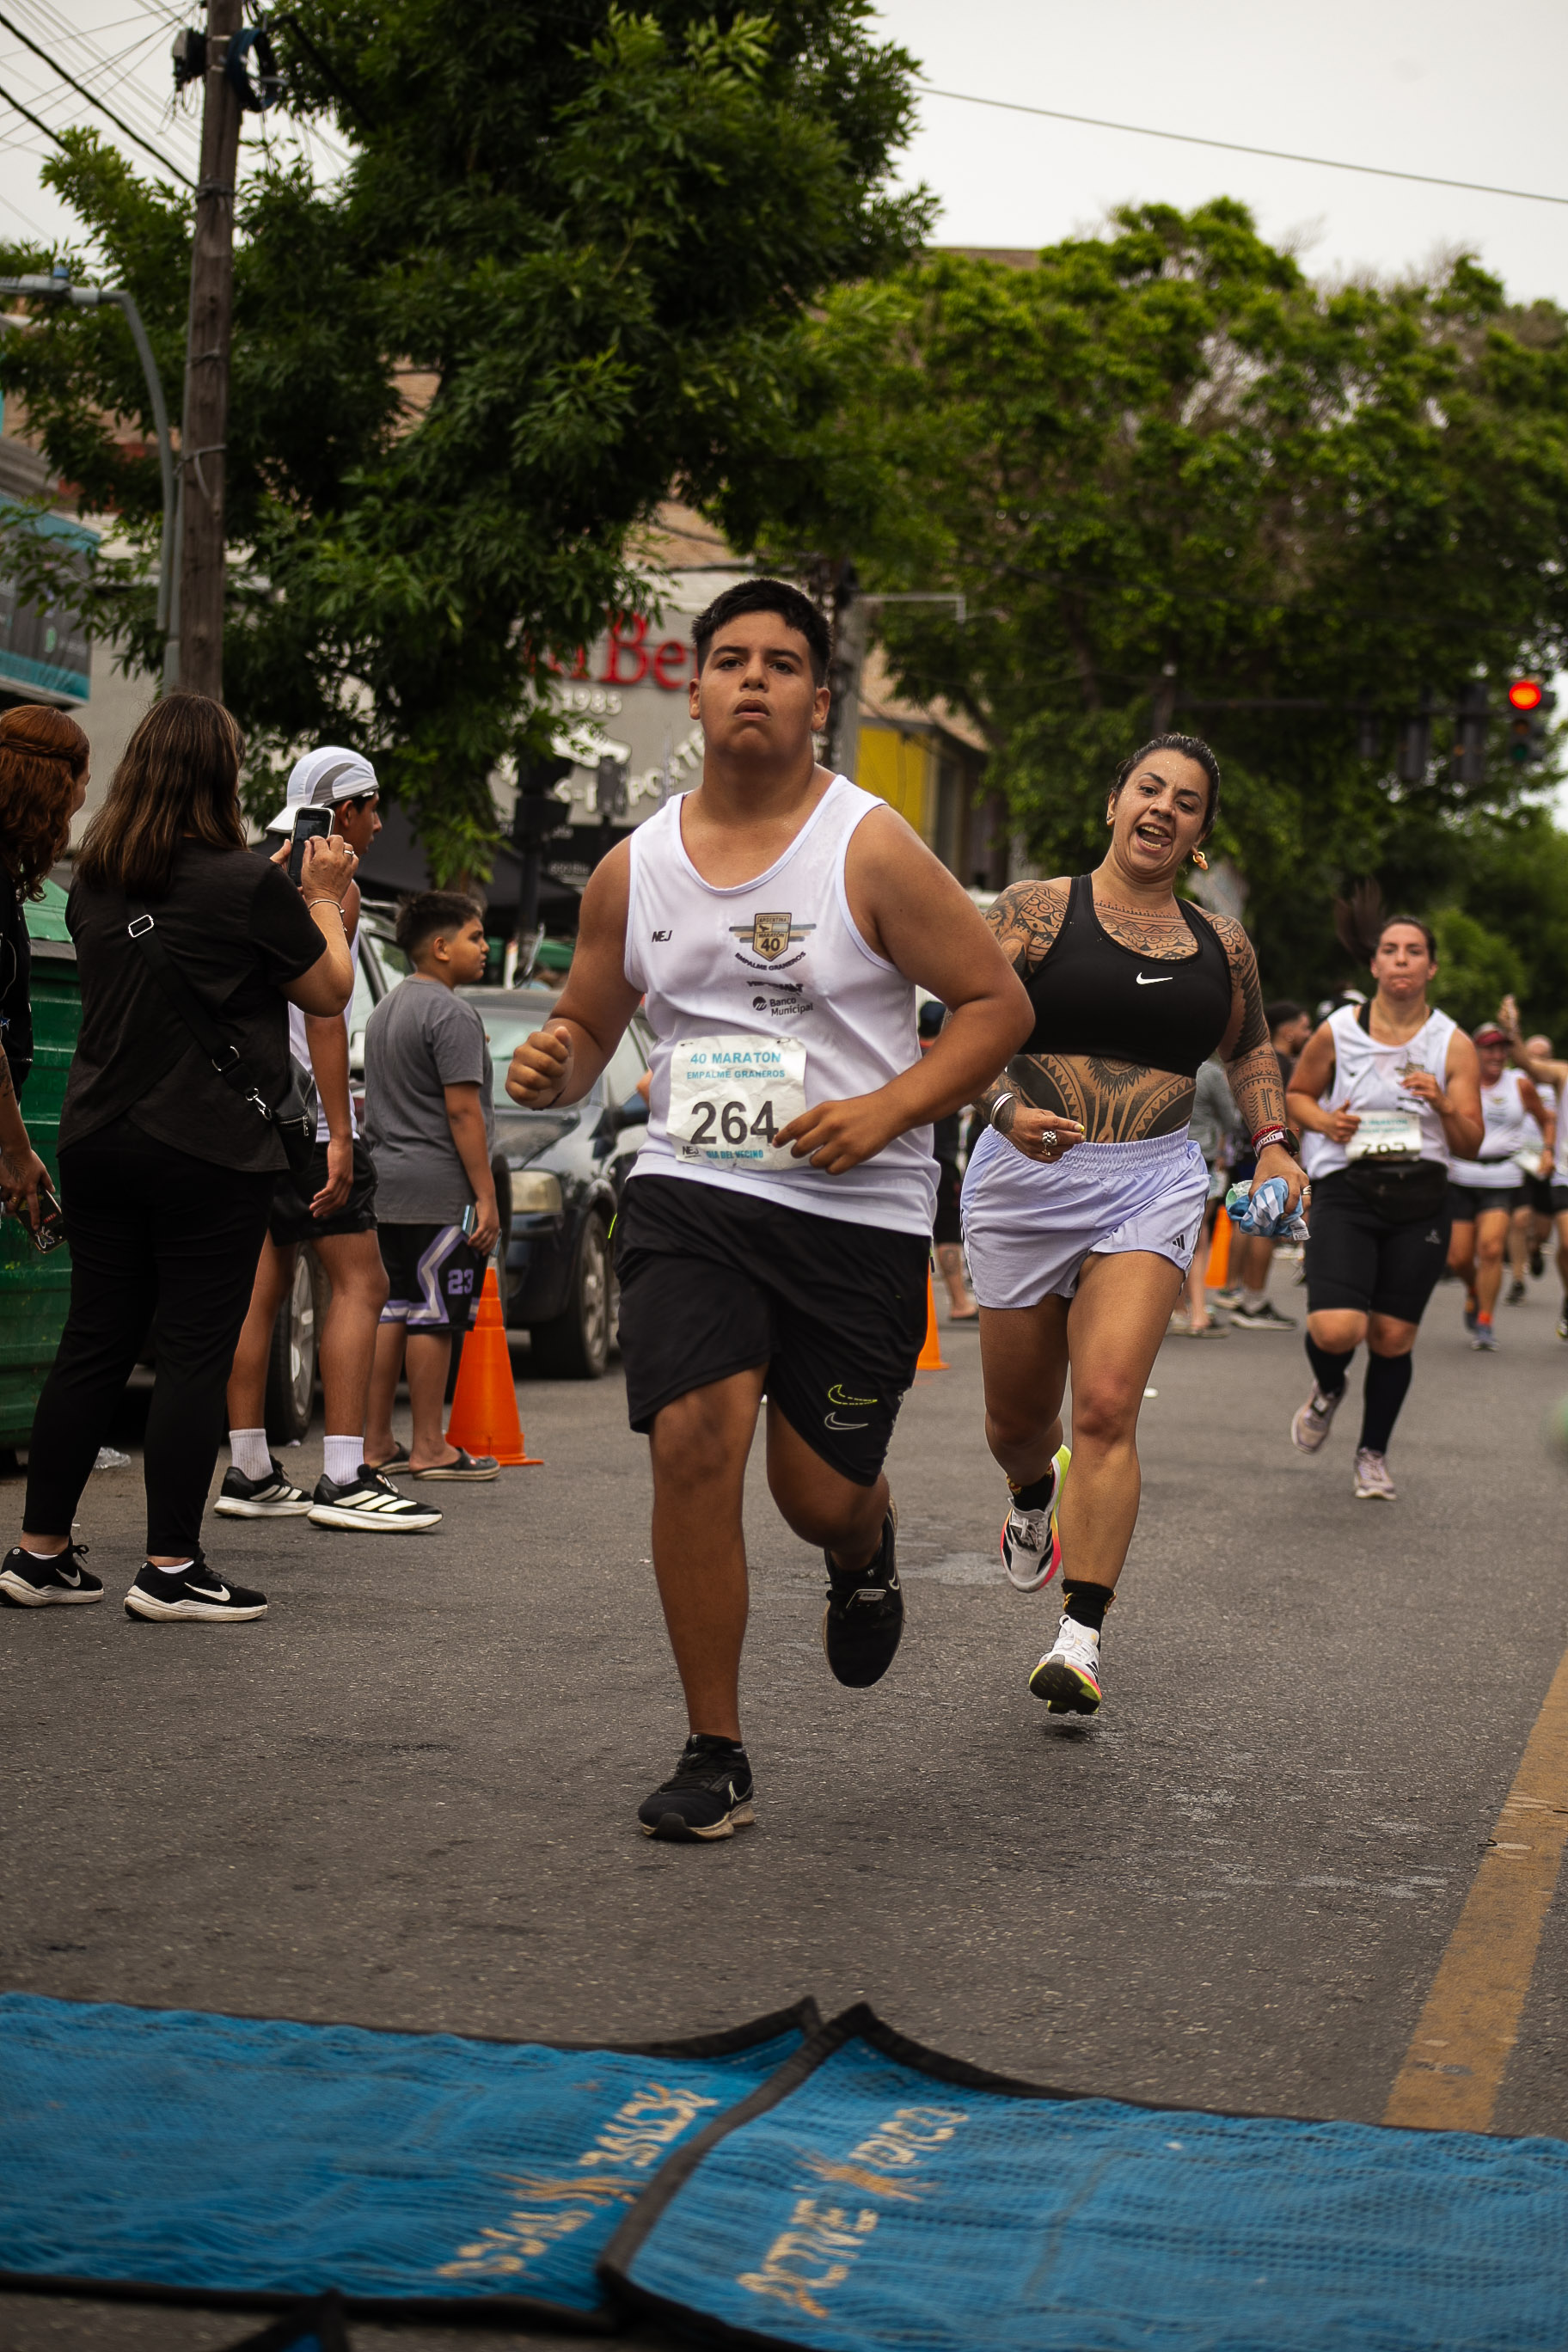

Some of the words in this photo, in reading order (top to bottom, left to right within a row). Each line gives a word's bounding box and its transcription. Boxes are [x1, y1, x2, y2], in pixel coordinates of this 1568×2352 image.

[599, 608, 699, 689] Be
[652, 929, 672, 942] NEJ
[761, 938, 781, 952] 40
[735, 952, 768, 971] EMPALME
[769, 951, 806, 971] GRANEROS
[769, 997, 797, 1007] Banco
[771, 1002, 813, 1017] Municipal
[690, 1053, 707, 1064] 40
[712, 1052, 781, 1063] MARATON
[687, 1070, 732, 1080] EMPALME
[734, 1069, 786, 1079] GRANEROS
[690, 1100, 779, 1145] 264
[448, 1269, 475, 1295] 23
